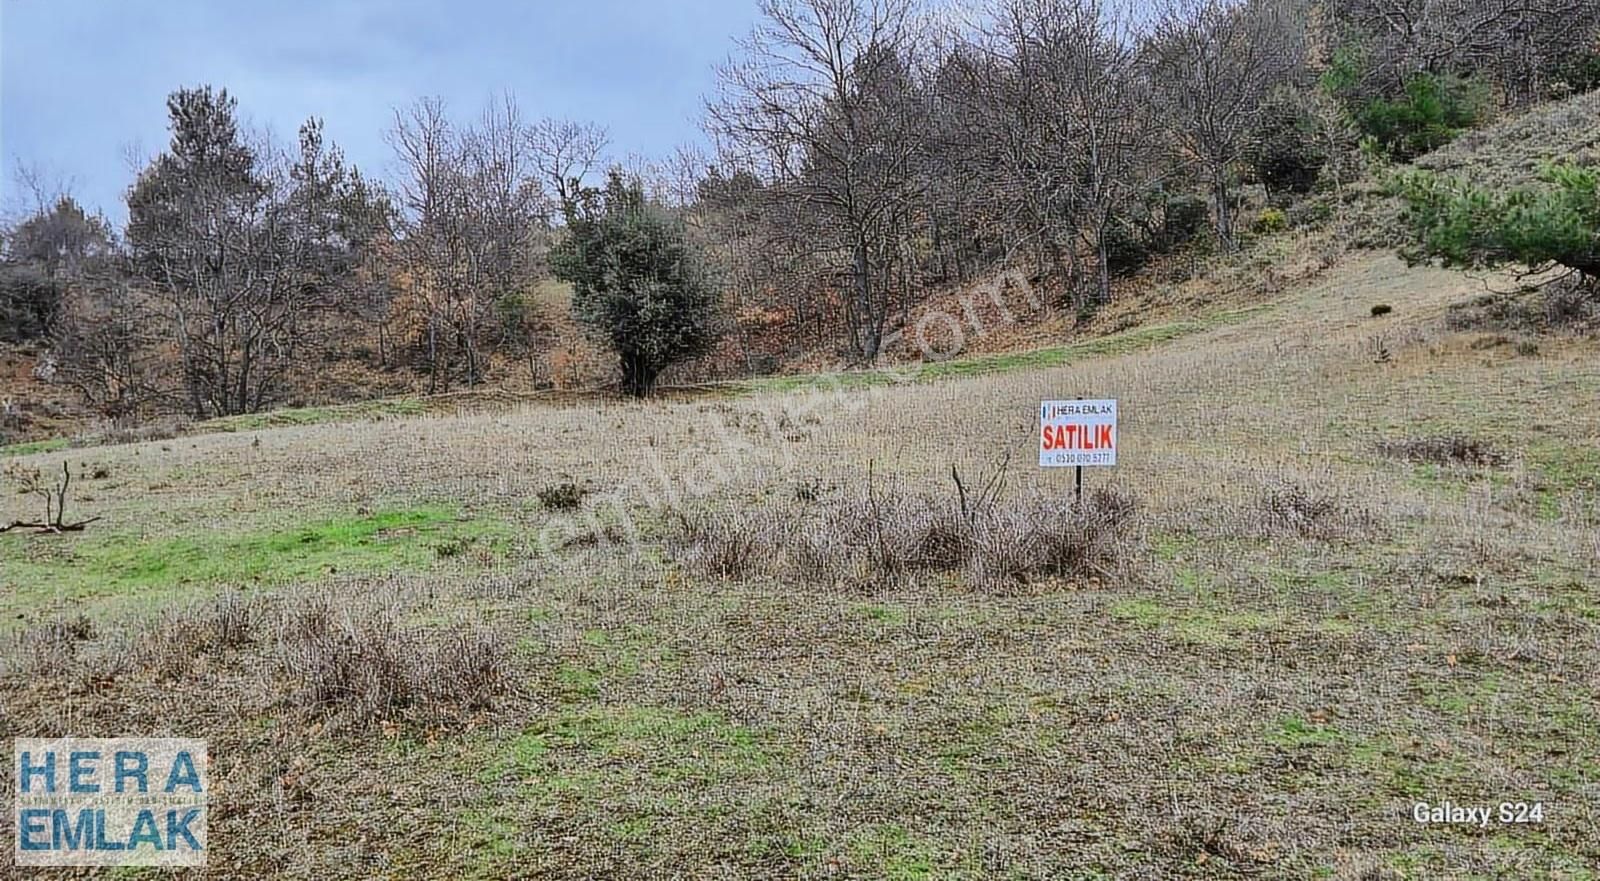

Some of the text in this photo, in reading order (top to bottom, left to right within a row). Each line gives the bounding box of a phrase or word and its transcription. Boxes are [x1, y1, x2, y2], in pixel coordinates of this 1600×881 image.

[1057, 404, 1112, 415] HERA EMLAK
[1042, 425, 1112, 450] SATILIK
